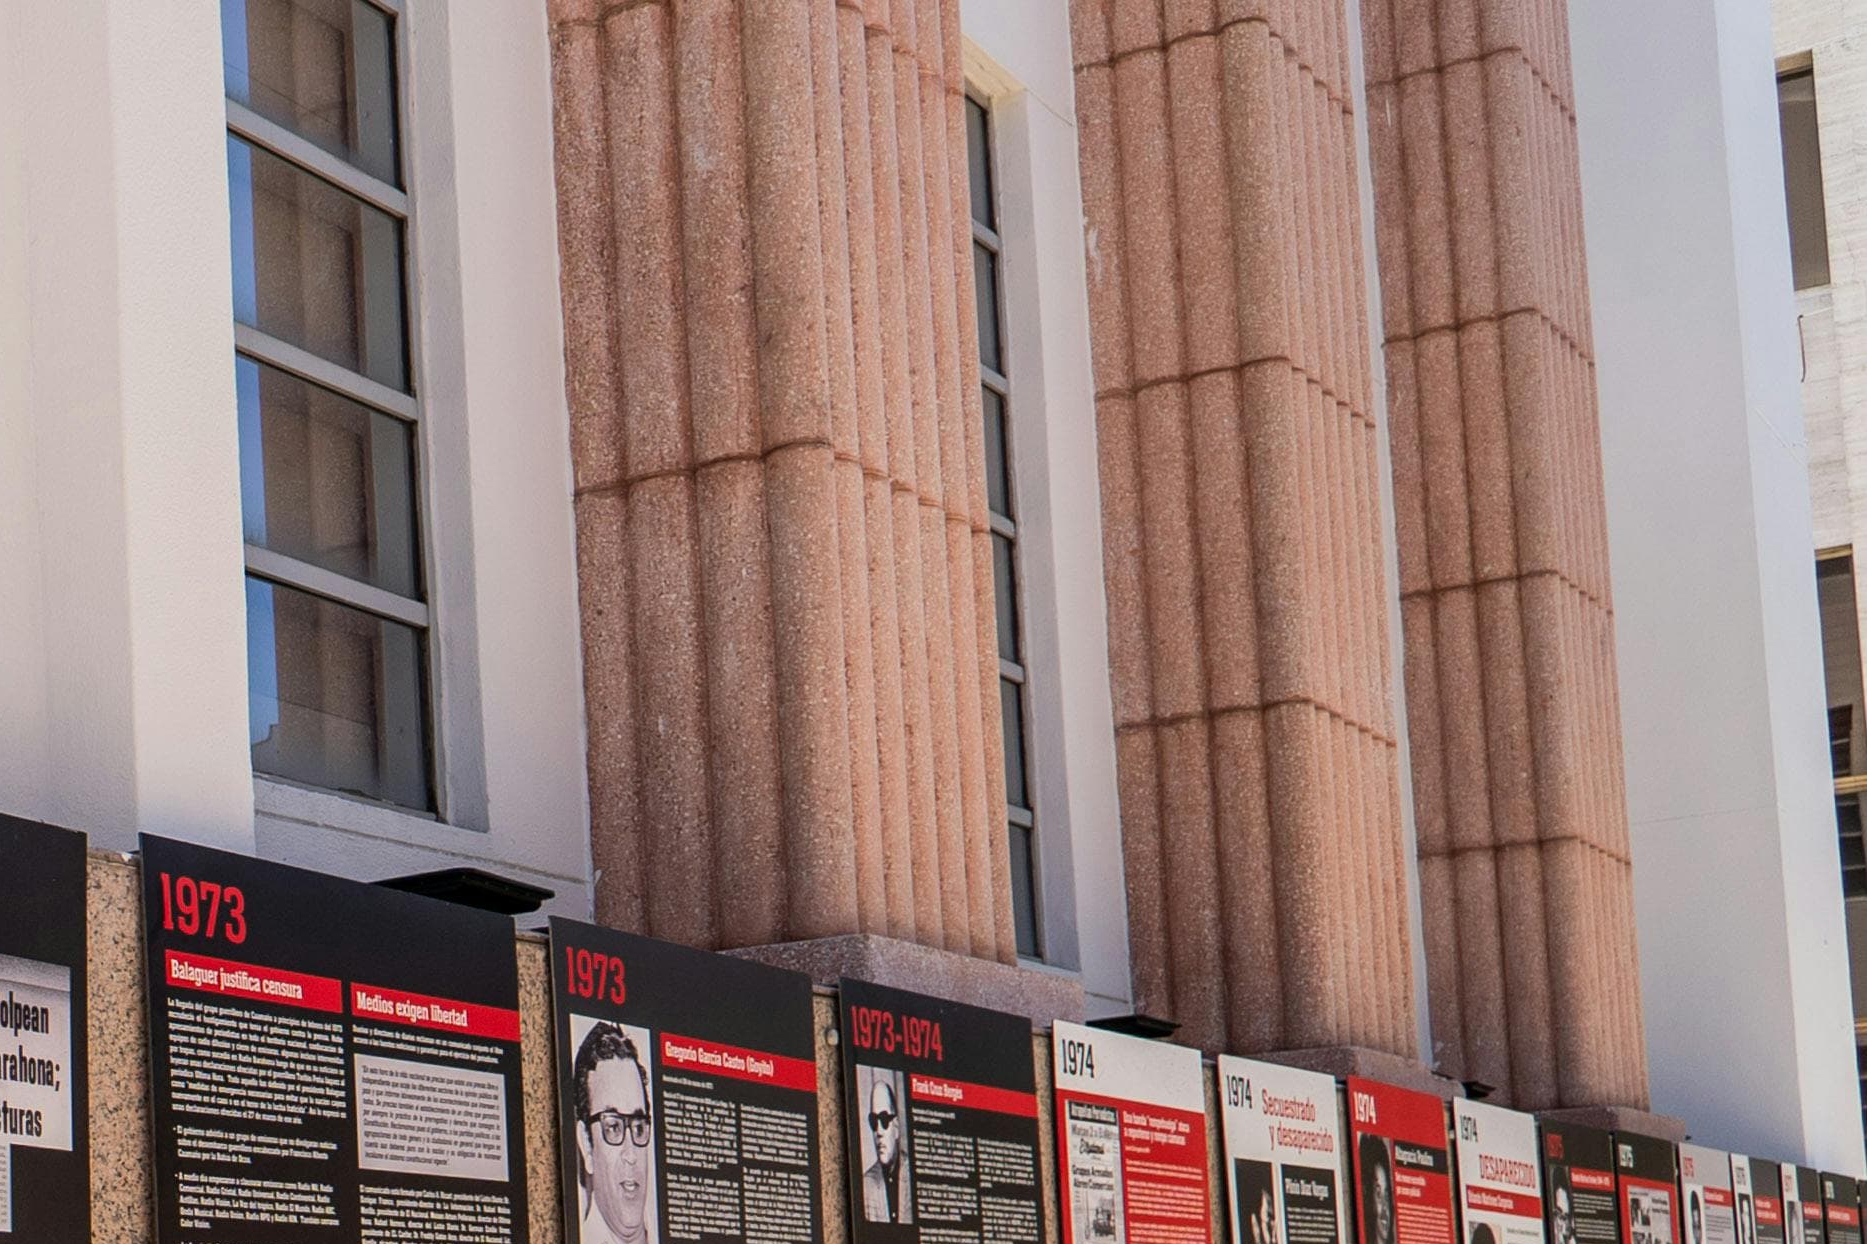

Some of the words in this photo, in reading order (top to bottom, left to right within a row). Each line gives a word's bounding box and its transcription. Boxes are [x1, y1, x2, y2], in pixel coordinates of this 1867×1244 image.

[160, 872, 248, 945] 1973
[170, 958, 218, 986] Balaguer
[219, 967, 261, 992] justifica
[262, 978, 302, 999] censura
[566, 946, 626, 1005] 1973
[356, 990, 394, 1014] Medios
[395, 999, 429, 1022] exigen
[429, 1004, 467, 1026] libertad
[851, 1005, 944, 1062] 1973-1974
[1061, 1038, 1095, 1079] 1974
[1226, 1074, 1253, 1110] 1974
[1353, 1091, 1377, 1125] 1974
